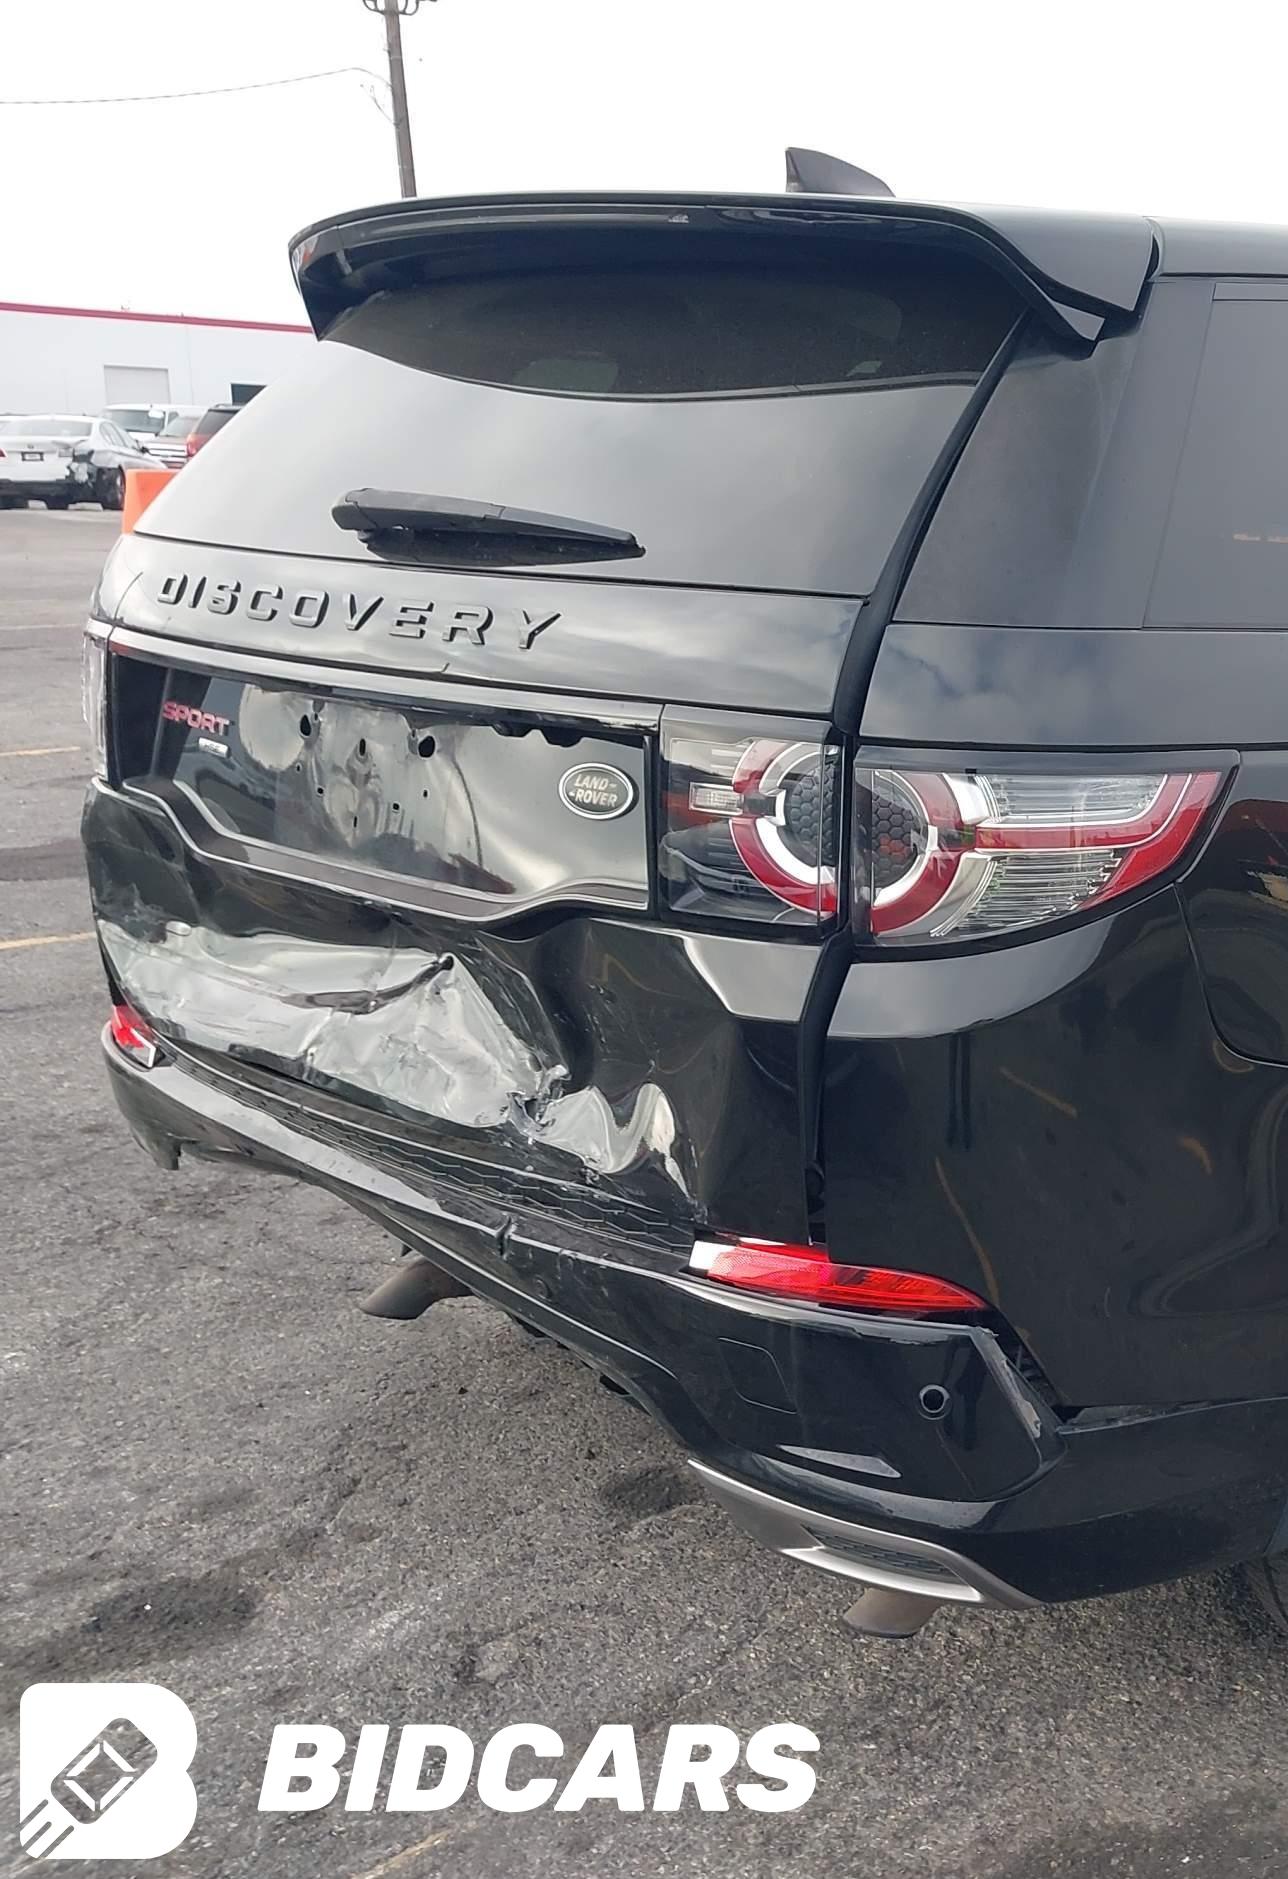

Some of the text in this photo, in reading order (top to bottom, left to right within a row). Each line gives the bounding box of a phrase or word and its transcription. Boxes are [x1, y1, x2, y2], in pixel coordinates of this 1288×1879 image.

[157, 574, 562, 650] DISCOVERY
[162, 702, 230, 736] SPORT
[574, 774, 609, 790] LAND
[575, 788, 618, 807] ROVER
